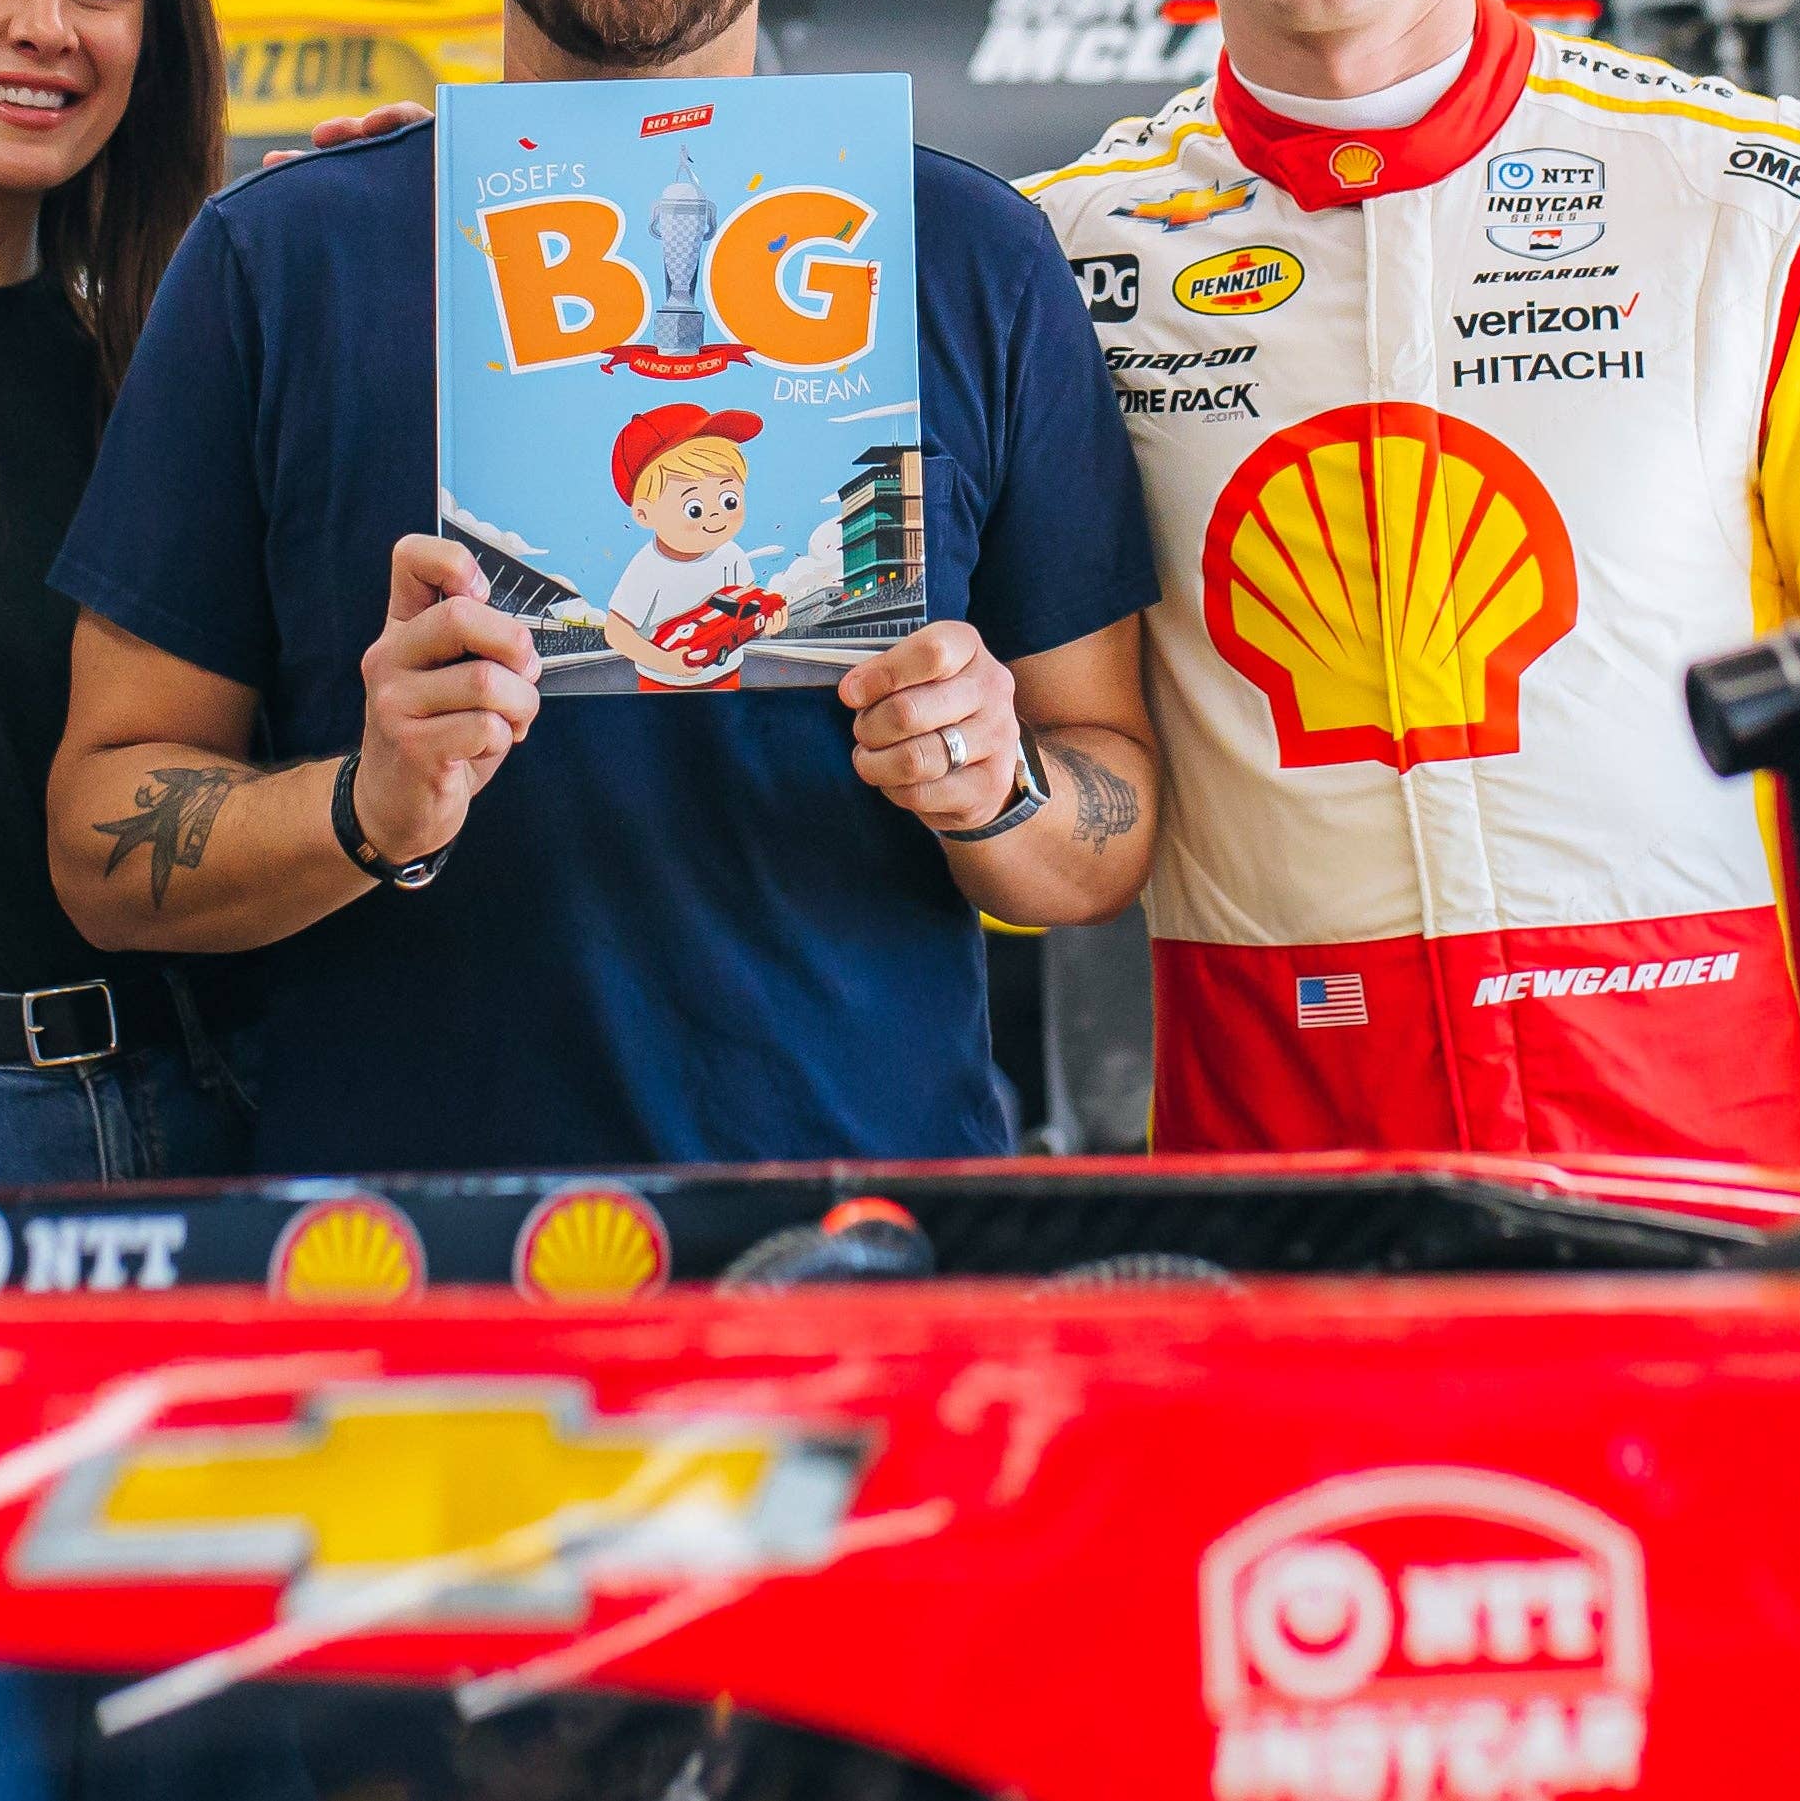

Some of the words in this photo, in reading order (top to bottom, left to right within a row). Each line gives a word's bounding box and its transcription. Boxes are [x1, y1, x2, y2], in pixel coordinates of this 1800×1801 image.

[647, 118, 669, 130] RED
[671, 109, 707, 125] RACER
[476, 162, 587, 203] JOSEF'S
[1541, 168, 1595, 184] NTT
[1487, 195, 1603, 212] INDYCAR
[1510, 212, 1577, 223] SERIES
[1472, 265, 1620, 285] NEWGARDEN
[1453, 301, 1620, 339] verizon
[1105, 345, 1258, 375] Snap-on
[1452, 351, 1644, 387] HITACHI
[773, 374, 872, 406] DREAM
[1116, 389, 1166, 413] TIRE
[1170, 382, 1261, 418] RACK
[1202, 411, 1245, 424] .com
[1472, 952, 1739, 1007] NEWGARDEN
[25, 1215, 187, 1292] NTT
[1401, 1558, 1597, 1666] NTT
